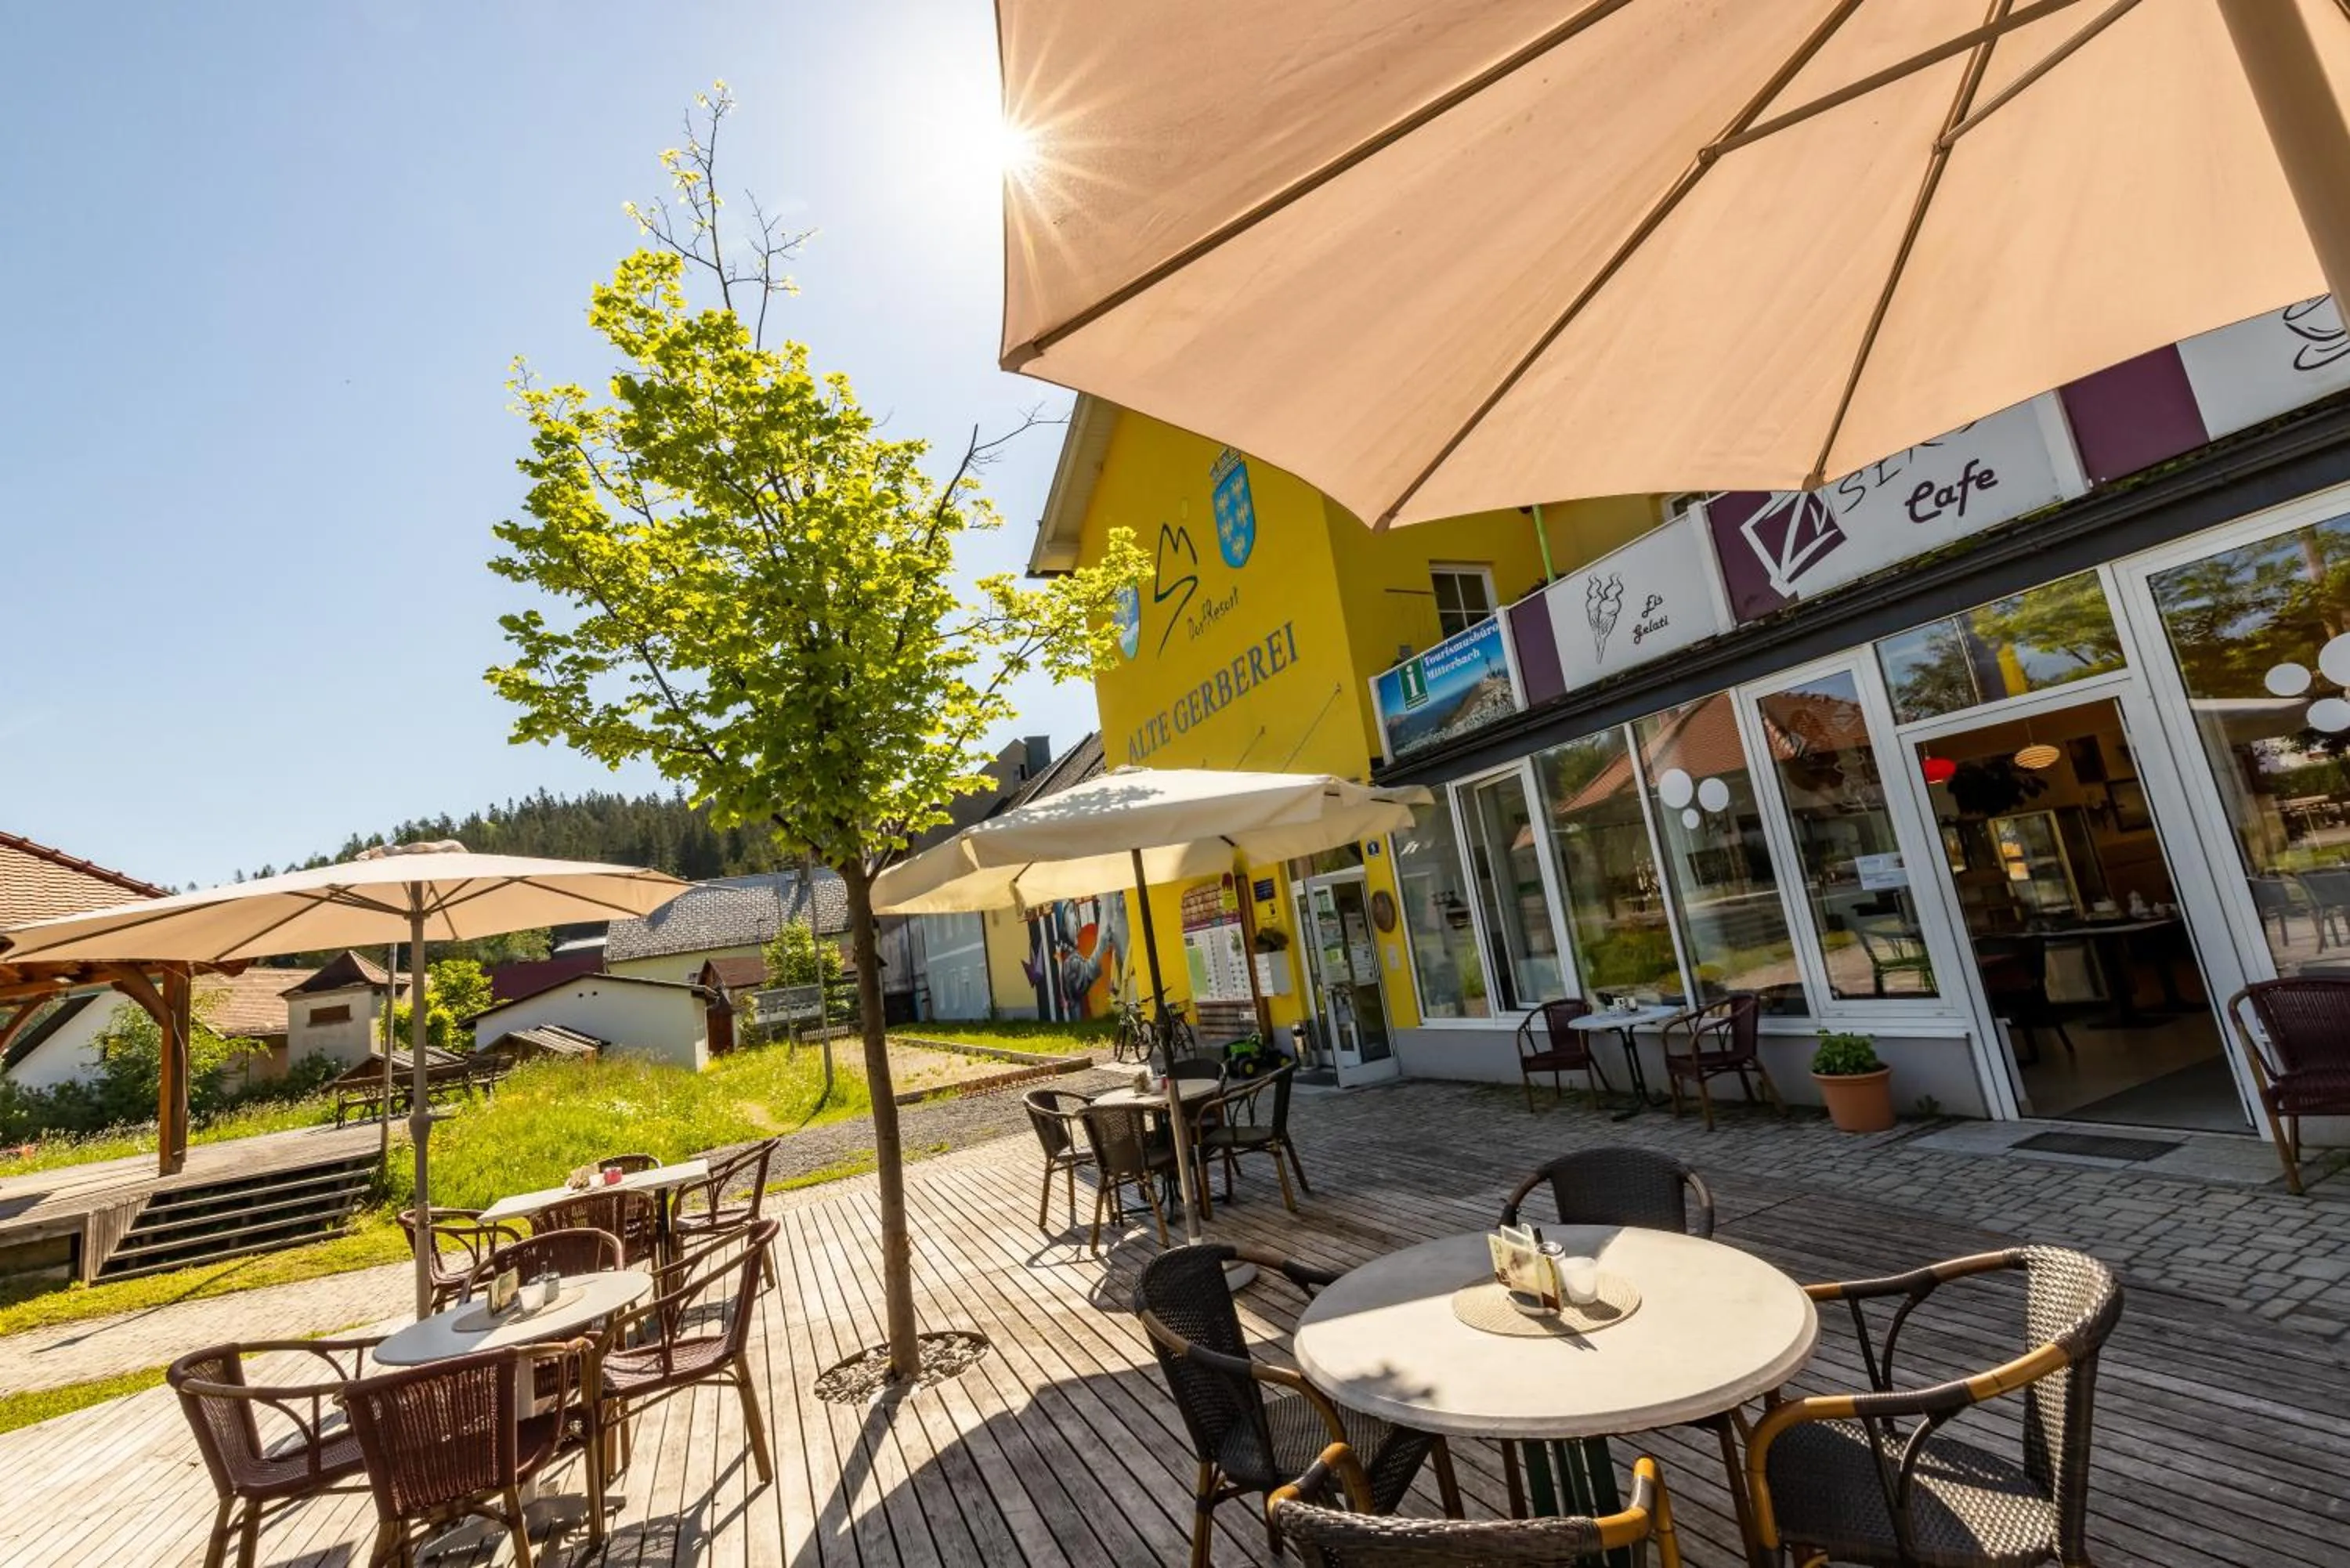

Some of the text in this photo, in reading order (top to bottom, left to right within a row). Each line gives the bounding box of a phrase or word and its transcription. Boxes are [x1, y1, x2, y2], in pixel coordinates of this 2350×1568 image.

[1424, 623, 1499, 667] Tourismusbüro
[1632, 615, 1669, 645] Gelati
[1426, 648, 1480, 680] Mitterbach
[1128, 620, 1299, 766] ALTE GERBEREI
